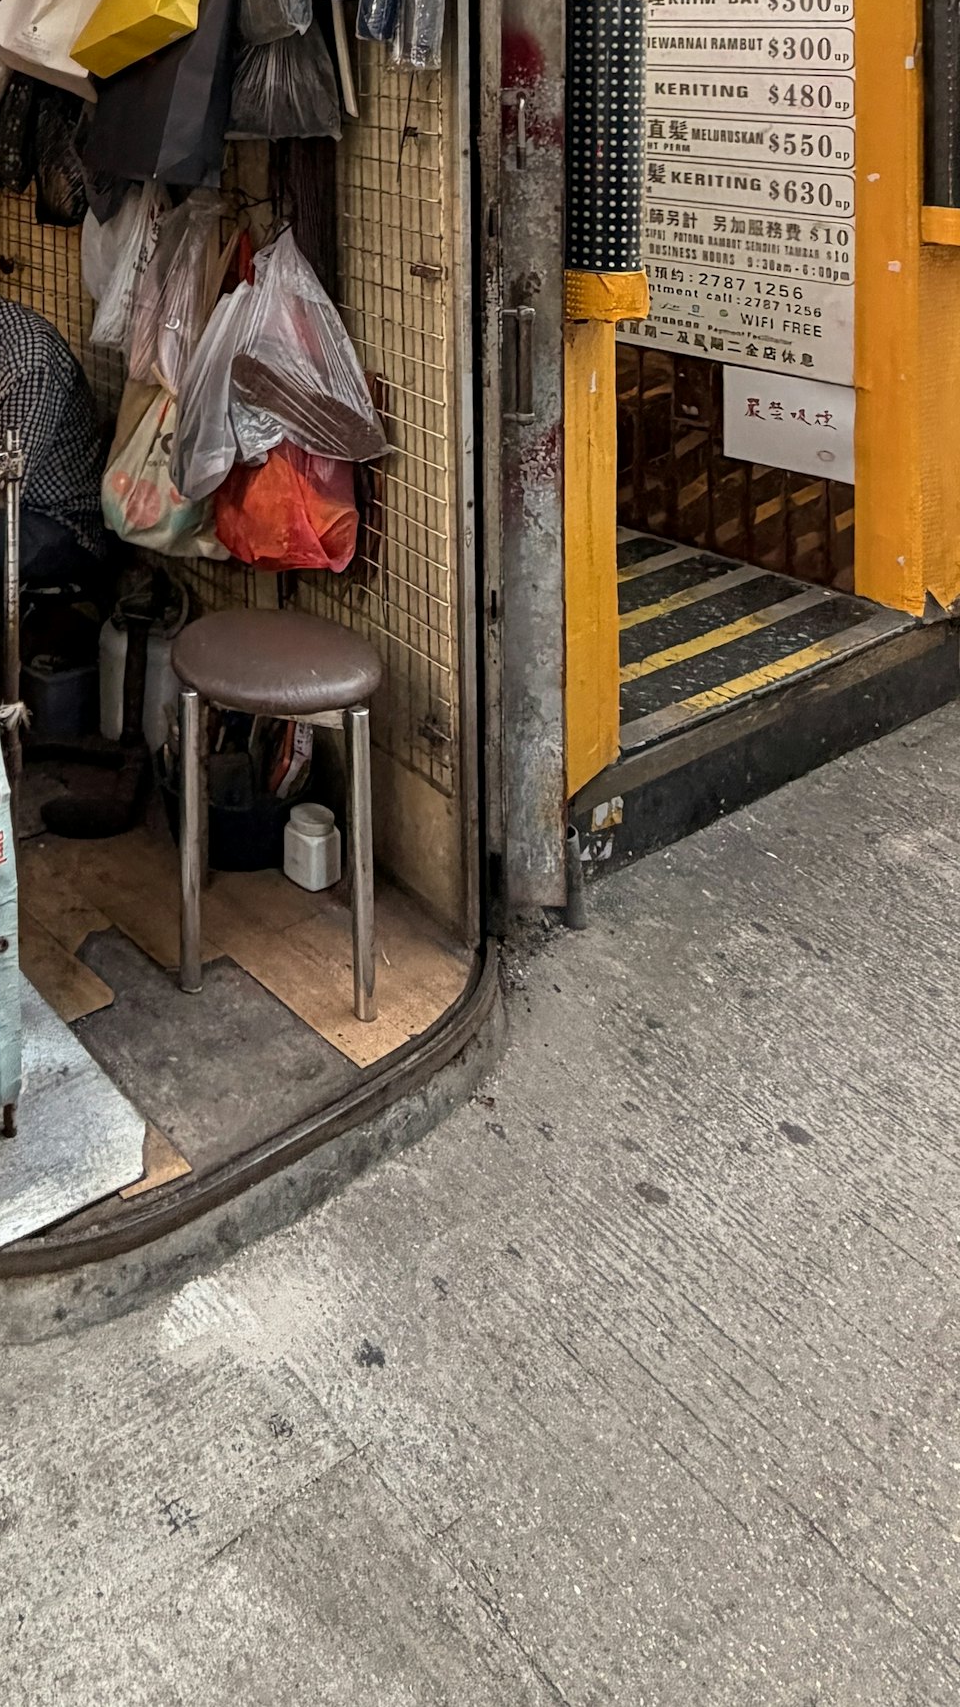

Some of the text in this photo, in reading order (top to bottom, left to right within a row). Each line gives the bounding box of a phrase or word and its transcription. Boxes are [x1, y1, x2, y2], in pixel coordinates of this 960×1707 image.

[711, 37, 763, 51] RAMBUT
[768, 36, 832, 61] $300
[654, 82, 749, 99] KERITING
[768, 83, 833, 109] $480
[647, 118, 689, 141] 直髮
[691, 127, 765, 145] MELURUSKAN
[769, 132, 833, 158] $550
[647, 162, 666, 185] 髮
[670, 170, 762, 192] KERITING
[769, 180, 833, 207] $630
[713, 214, 802, 242] 另加服務費
[809, 225, 849, 247] $10
[649, 243, 697, 261] BUSINESS
[702, 249, 735, 266] HOURS
[698, 273, 746, 291] 2787
[754, 281, 803, 300] 1256
[744, 296, 780, 312] 2787
[786, 303, 822, 318] 1256
[740, 312, 775, 330] WIFI
[782, 320, 823, 338] FREE
